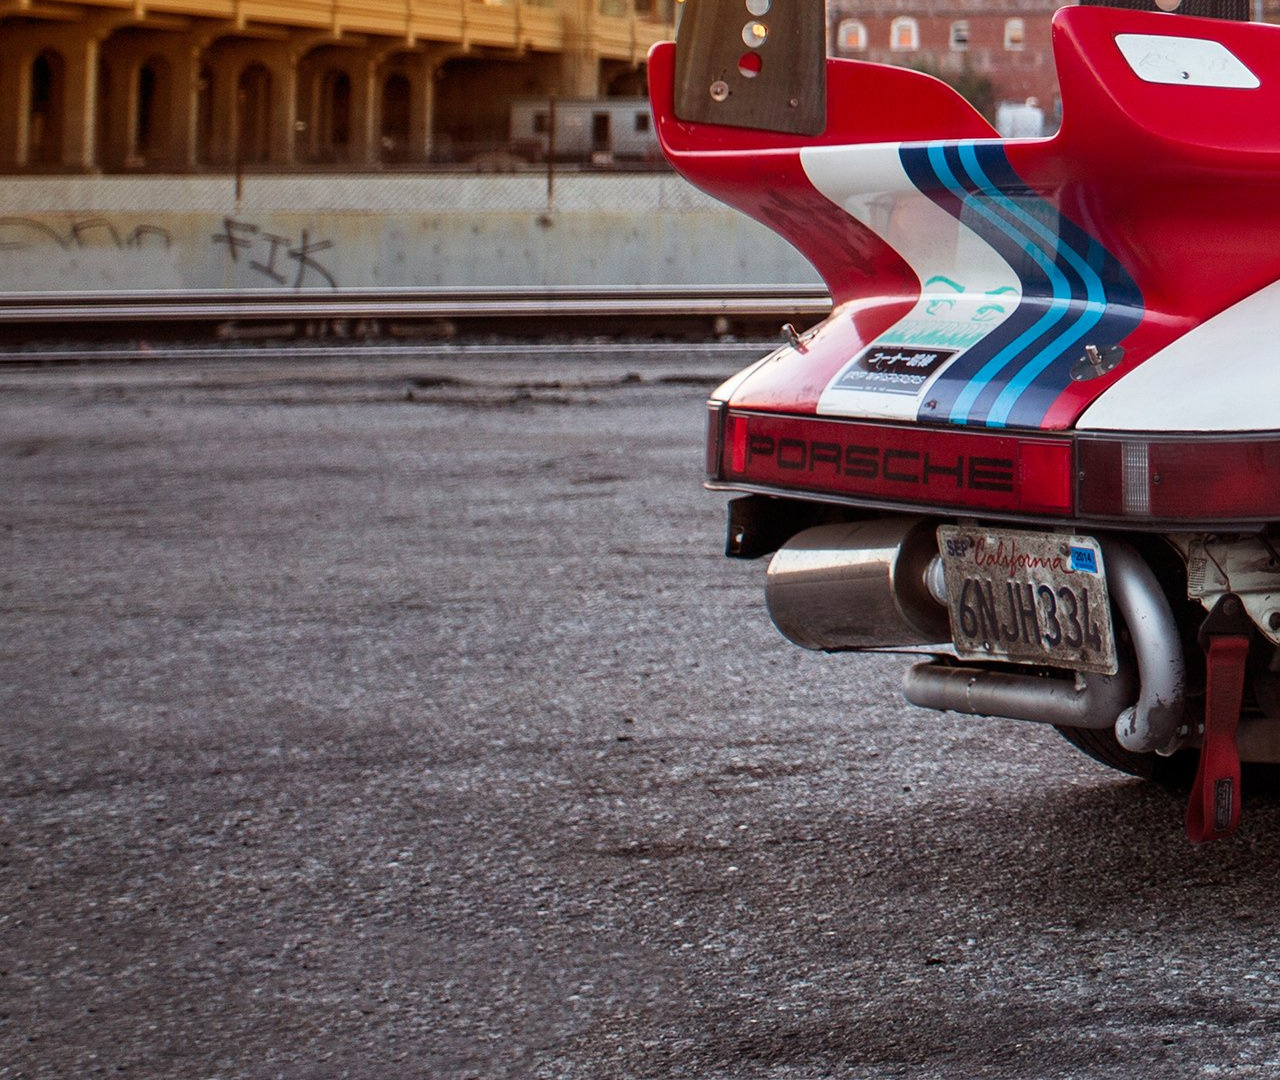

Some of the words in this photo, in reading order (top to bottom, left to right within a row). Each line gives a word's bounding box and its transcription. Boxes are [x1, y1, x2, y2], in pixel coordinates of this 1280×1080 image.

[749, 435, 1013, 493] PORSCHE
[947, 539, 968, 557] SEP
[975, 537, 1075, 576] California
[1074, 551, 1092, 563] 2014
[960, 578, 1102, 651] 6NJH334
